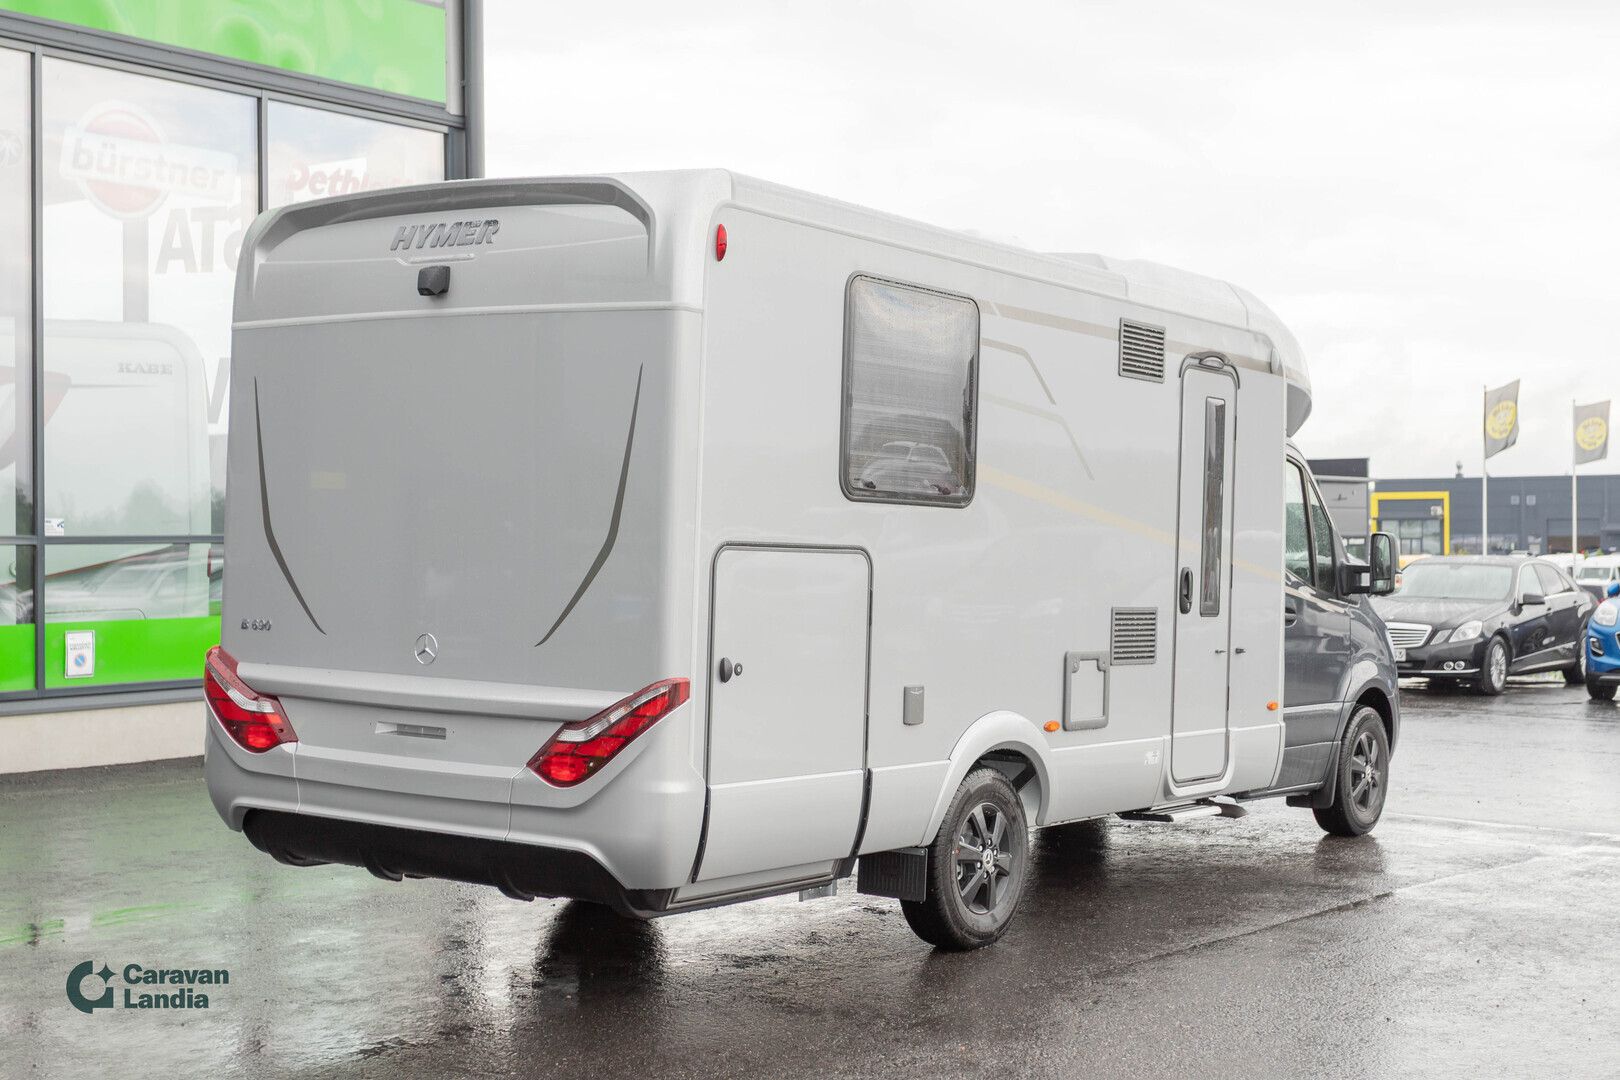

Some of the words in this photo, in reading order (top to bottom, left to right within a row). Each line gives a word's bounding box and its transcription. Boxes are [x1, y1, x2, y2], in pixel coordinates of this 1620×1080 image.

[72, 137, 225, 190] bürstner
[390, 219, 500, 251] HYMER
[117, 362, 173, 376] KABE
